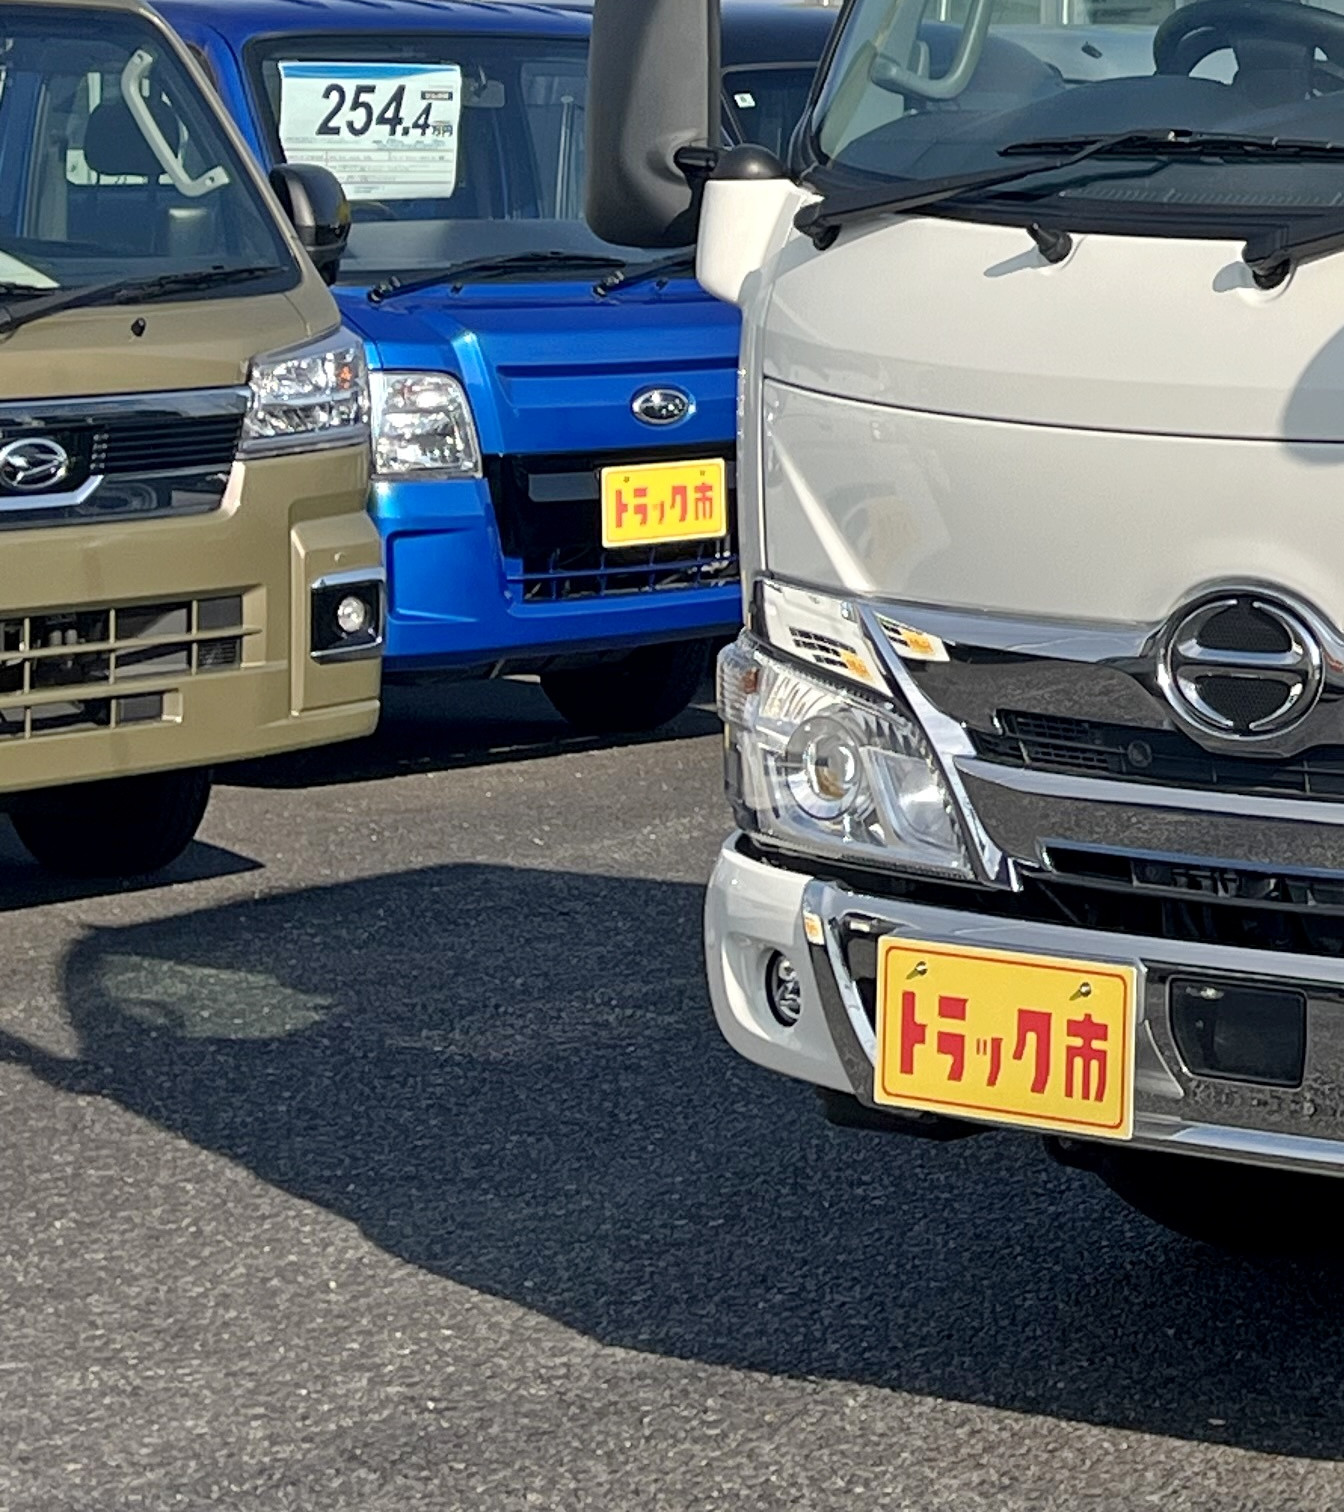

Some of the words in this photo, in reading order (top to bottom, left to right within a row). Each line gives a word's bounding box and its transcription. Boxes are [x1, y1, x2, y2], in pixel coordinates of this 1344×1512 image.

[615, 482, 714, 529] トラック市
[899, 989, 1109, 1103] トラック市
